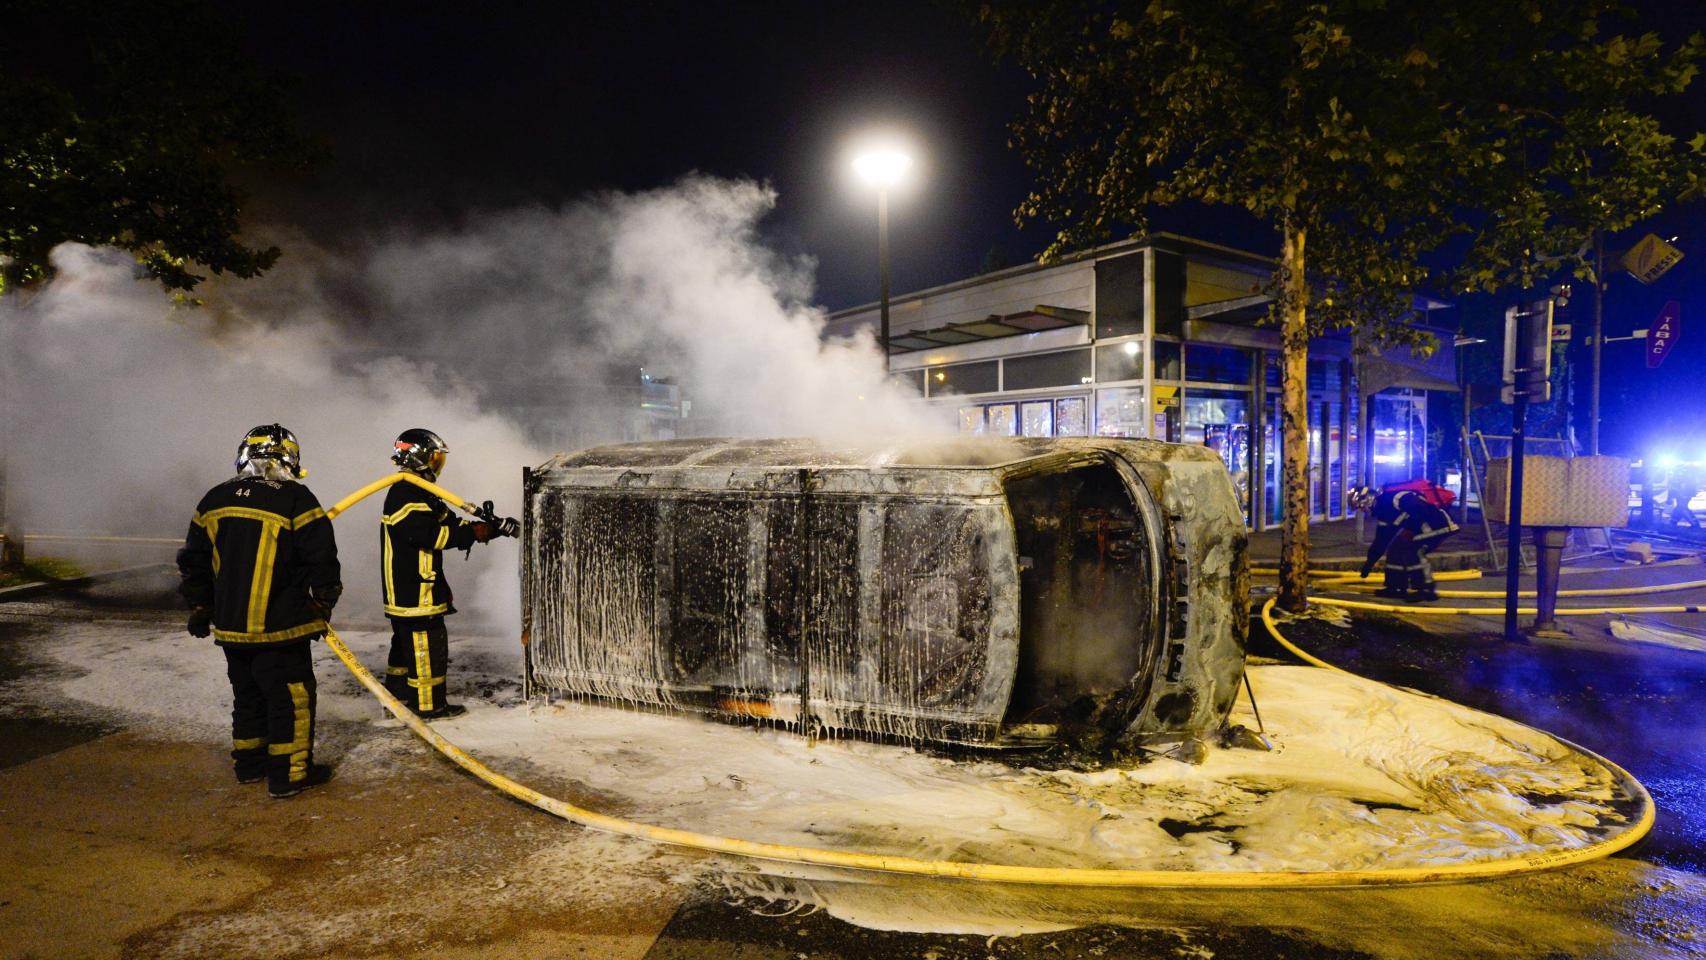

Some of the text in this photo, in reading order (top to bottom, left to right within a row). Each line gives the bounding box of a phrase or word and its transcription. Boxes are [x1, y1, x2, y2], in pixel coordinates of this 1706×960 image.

[1644, 251, 1680, 280] PRESSE
[1652, 316, 1673, 354] TABAC
[235, 488, 251, 498] 44
